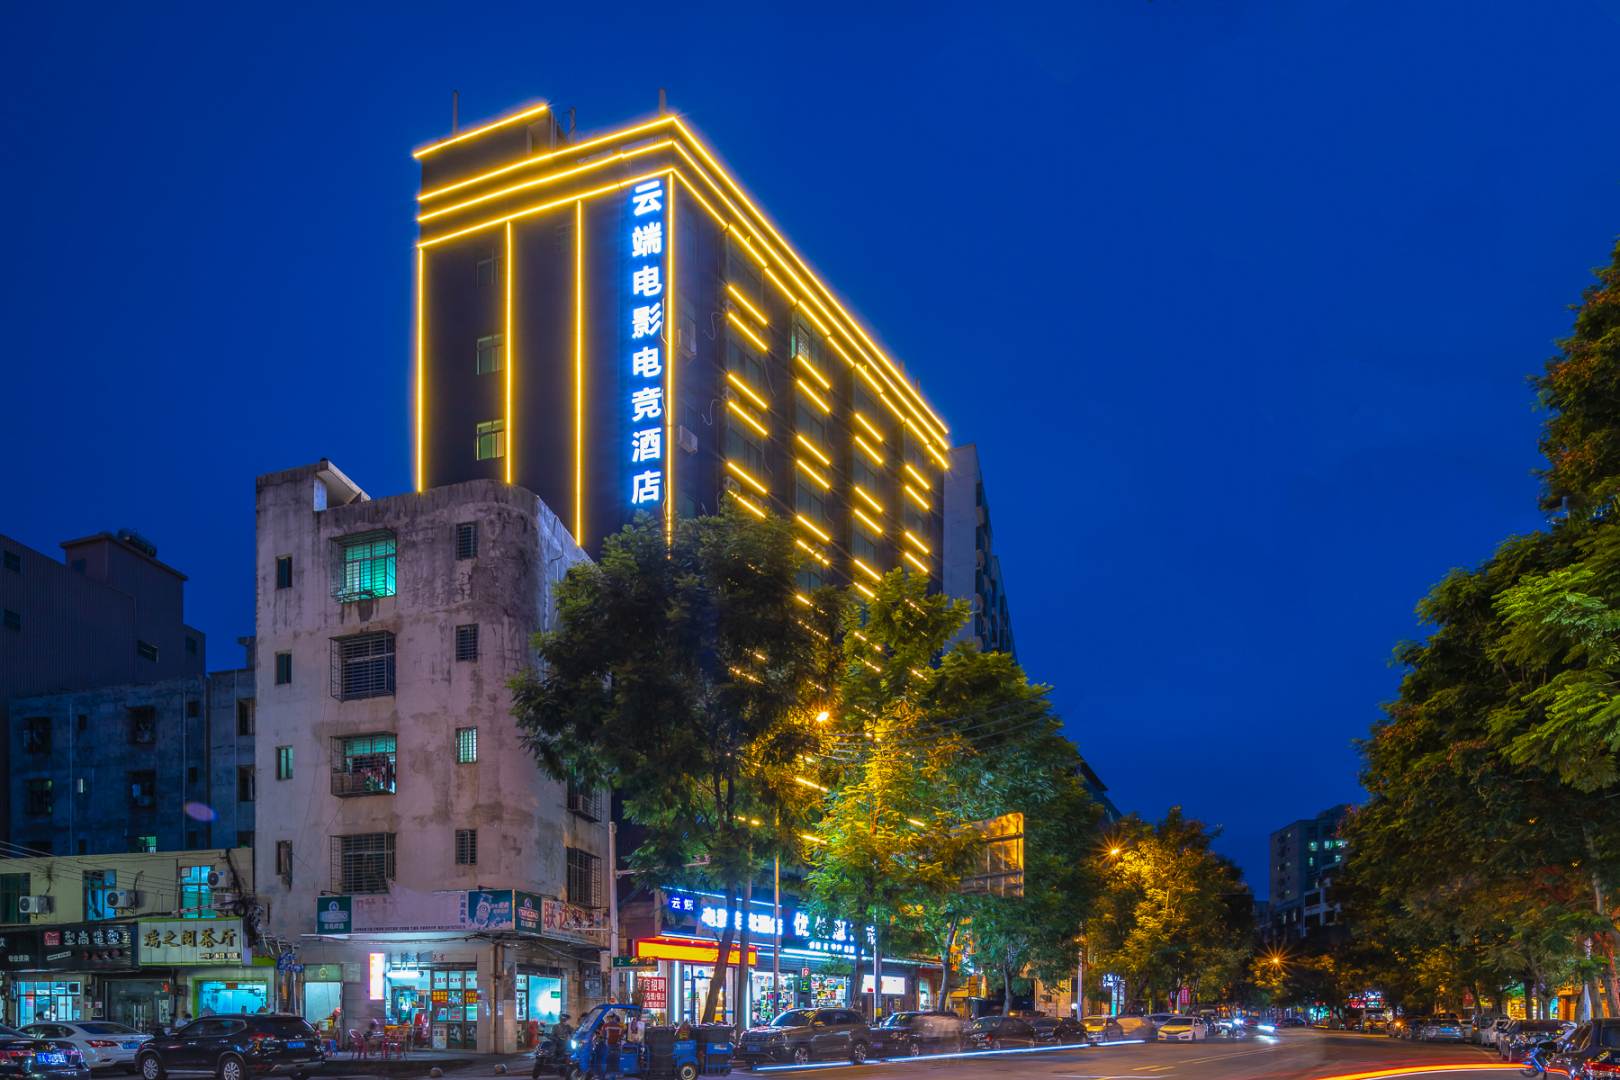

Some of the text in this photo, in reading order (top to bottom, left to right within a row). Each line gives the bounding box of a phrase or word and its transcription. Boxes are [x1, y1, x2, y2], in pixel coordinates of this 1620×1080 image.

[631, 180, 662, 504] 云端电影电竞酒店
